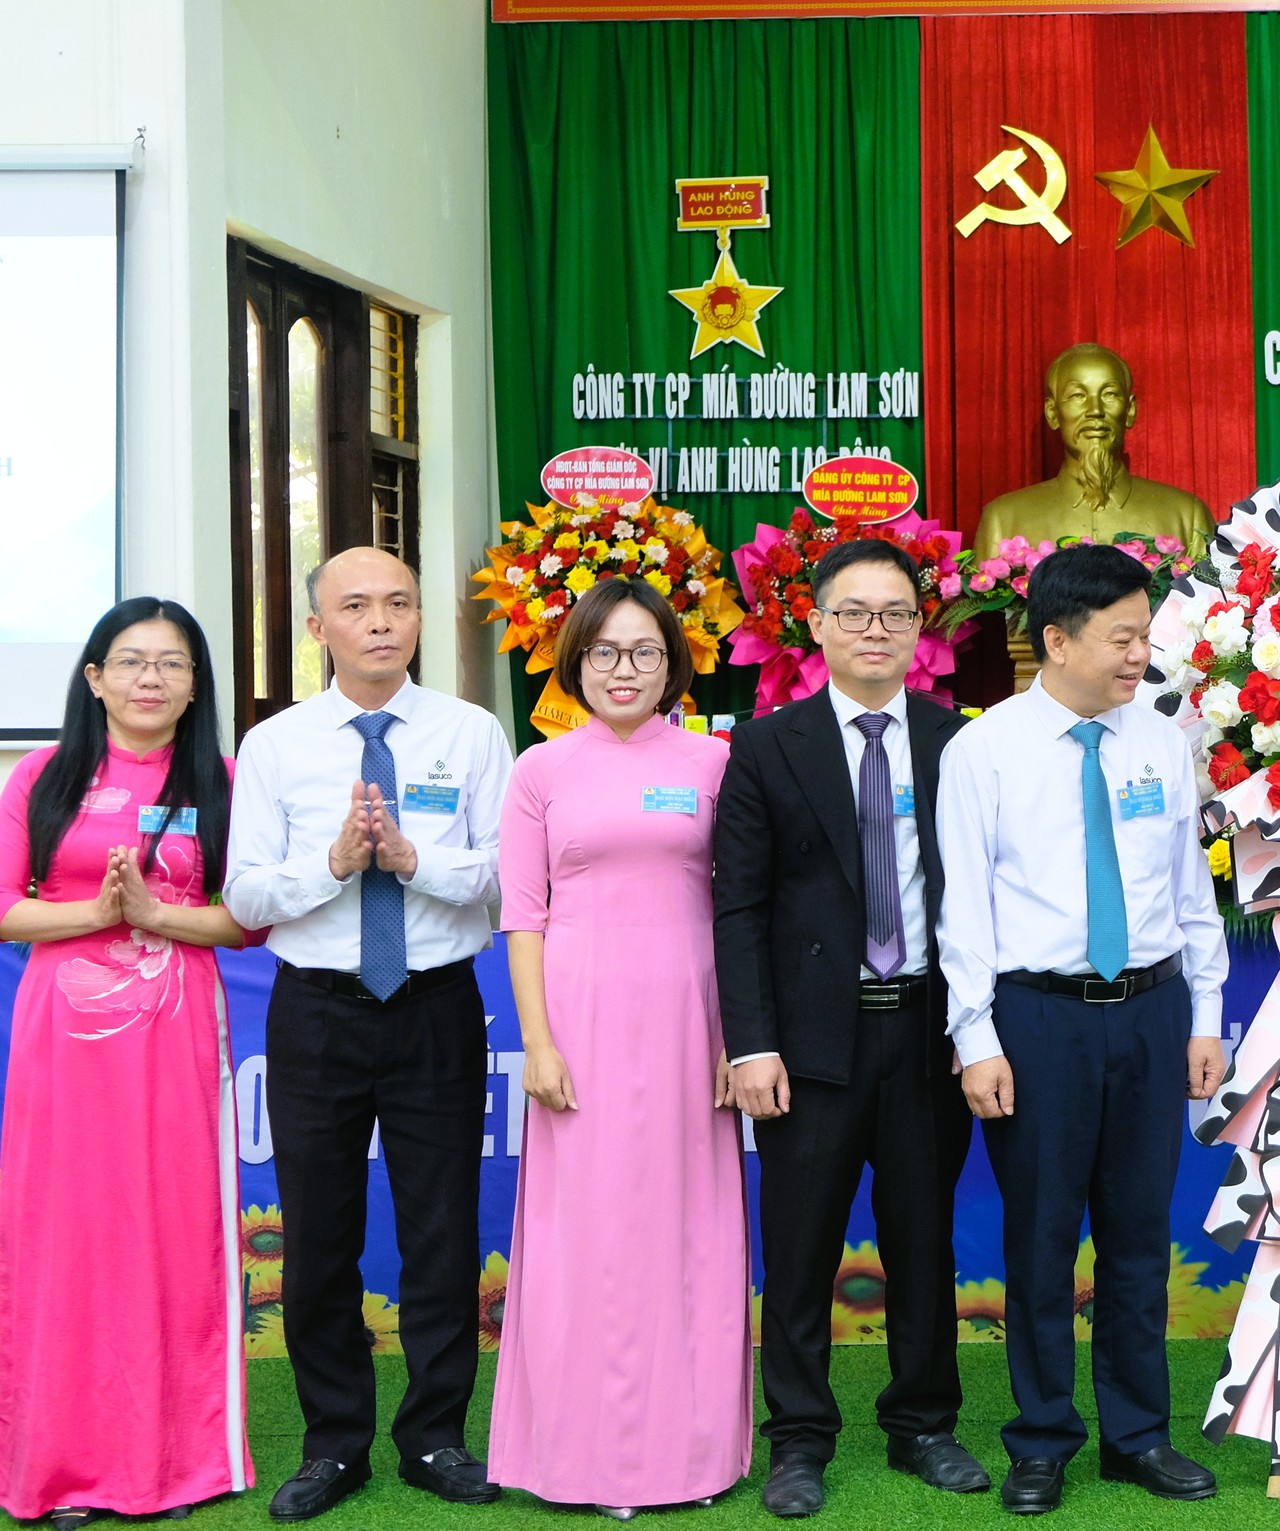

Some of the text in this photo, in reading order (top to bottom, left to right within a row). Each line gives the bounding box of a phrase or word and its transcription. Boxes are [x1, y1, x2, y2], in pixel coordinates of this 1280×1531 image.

[688, 192, 714, 202] ANH
[690, 203, 753, 218] LAO ĐỘNG
[572, 362, 920, 419] CÔNG TY CP MÍA ĐƯỜNG LAM SƠN
[677, 447, 718, 493] ANH
[728, 437, 780, 492] HÙNG
[565, 478, 574, 489] TY
[621, 478, 635, 489] LAM
[813, 468, 911, 487] ĐẢNG ỦY CÔNG TY CP
[812, 487, 908, 504] MÍA ĐƯỜNG LAM SƠN
[428, 772, 453, 780] lasuco
